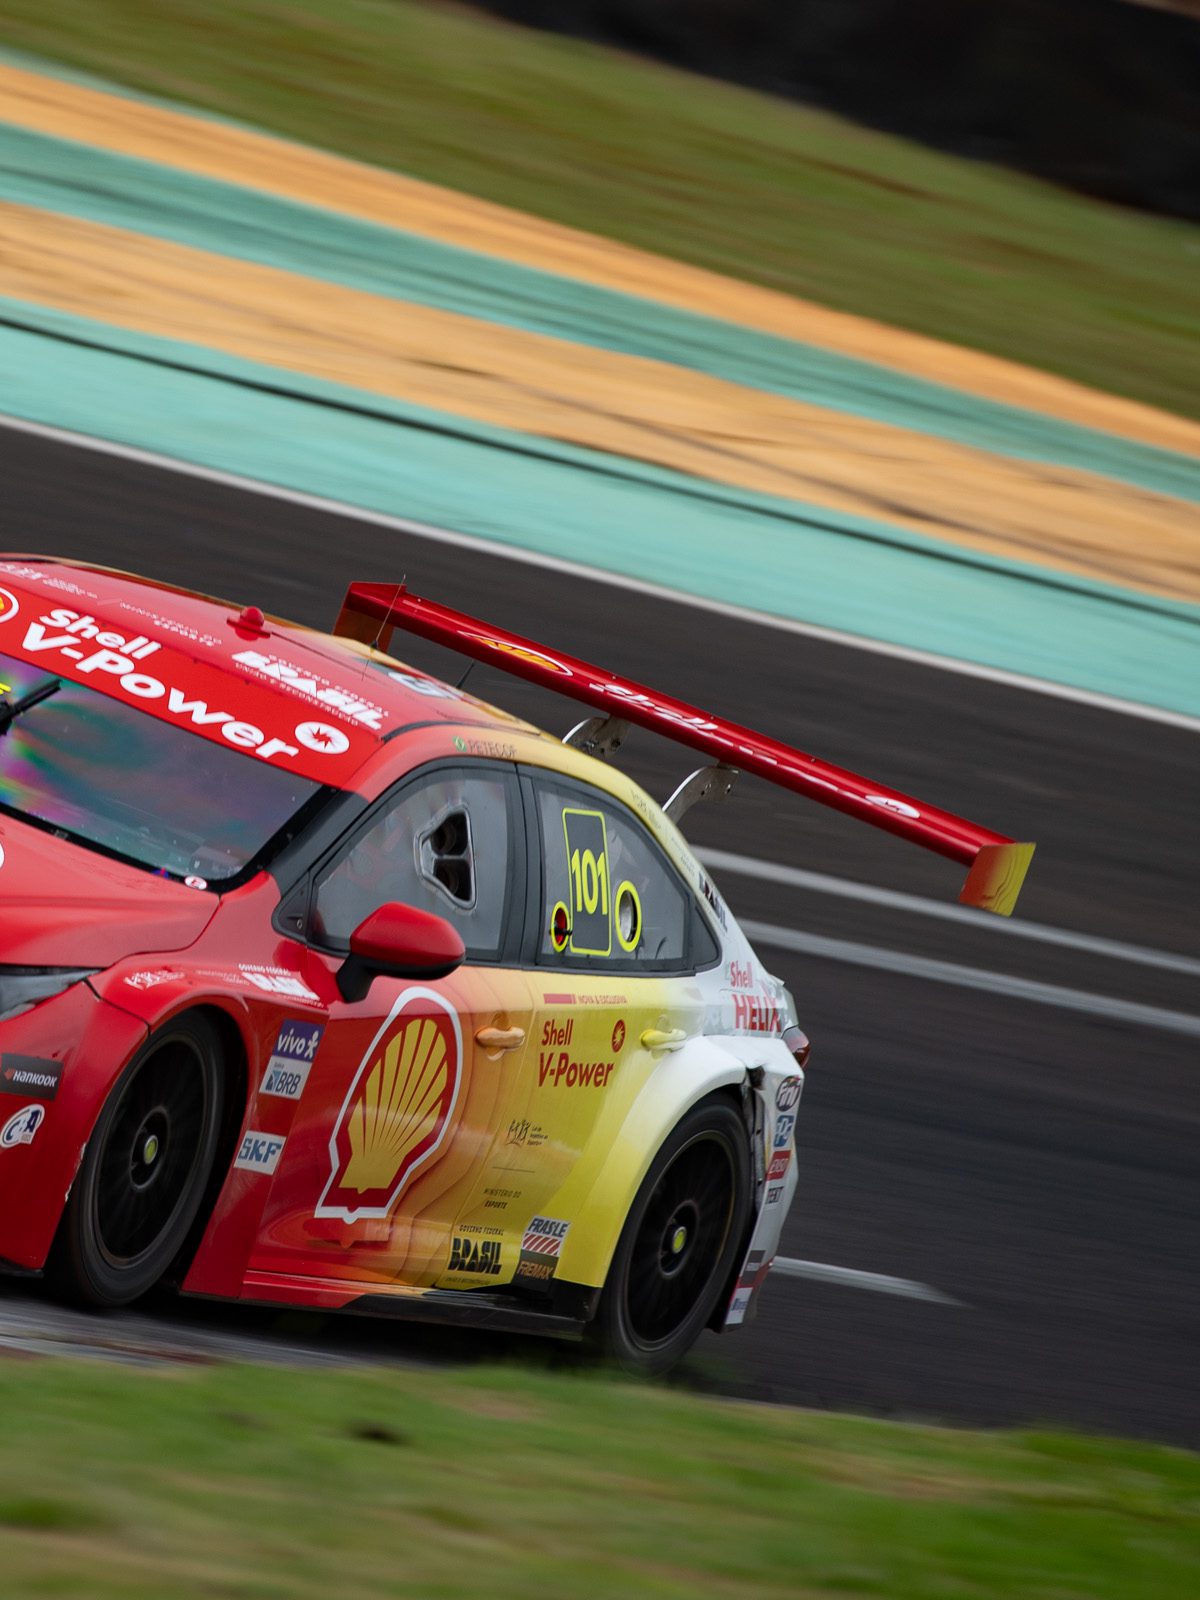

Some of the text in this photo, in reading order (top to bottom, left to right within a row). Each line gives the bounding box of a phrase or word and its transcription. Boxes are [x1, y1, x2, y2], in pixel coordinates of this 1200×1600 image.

[39, 609, 161, 660] Shell
[21, 622, 300, 759] V-Power
[571, 848, 608, 915] 101
[730, 960, 753, 988] Shell
[732, 992, 783, 1033] HELIX
[277, 1028, 305, 1055] vivo
[541, 1019, 574, 1046] Shell
[275, 1071, 301, 1095] BRB
[538, 1052, 614, 1088] V-Power
[238, 1137, 282, 1163] SKF
[448, 1237, 502, 1275] BRASIL
